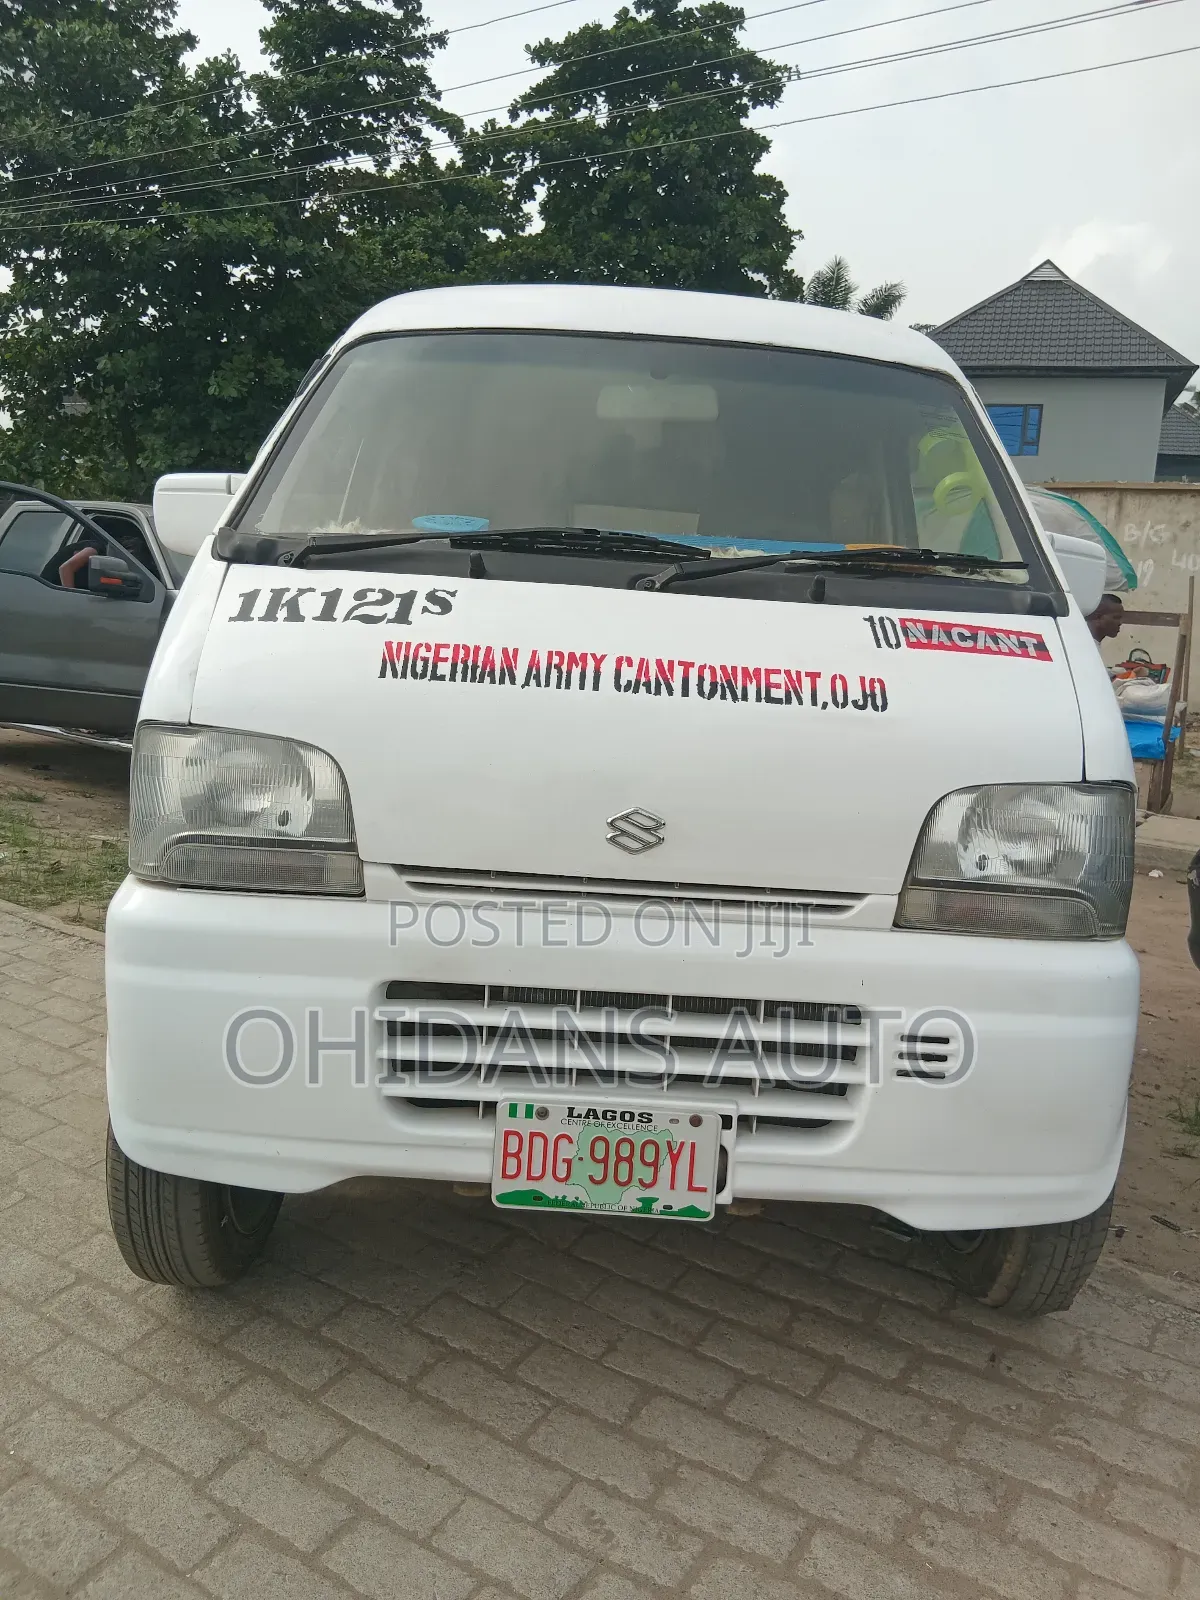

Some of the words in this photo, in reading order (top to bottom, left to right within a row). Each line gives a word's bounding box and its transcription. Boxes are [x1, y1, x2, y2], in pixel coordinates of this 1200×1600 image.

[863, 615, 902, 650] 10
[905, 621, 1038, 657] NACANT
[378, 641, 519, 685] NIGERIAN
[560, 1118, 592, 1127] CENTRE
[606, 1121, 659, 1132] EXCELLENCE
[567, 1107, 653, 1124] LAGOS
